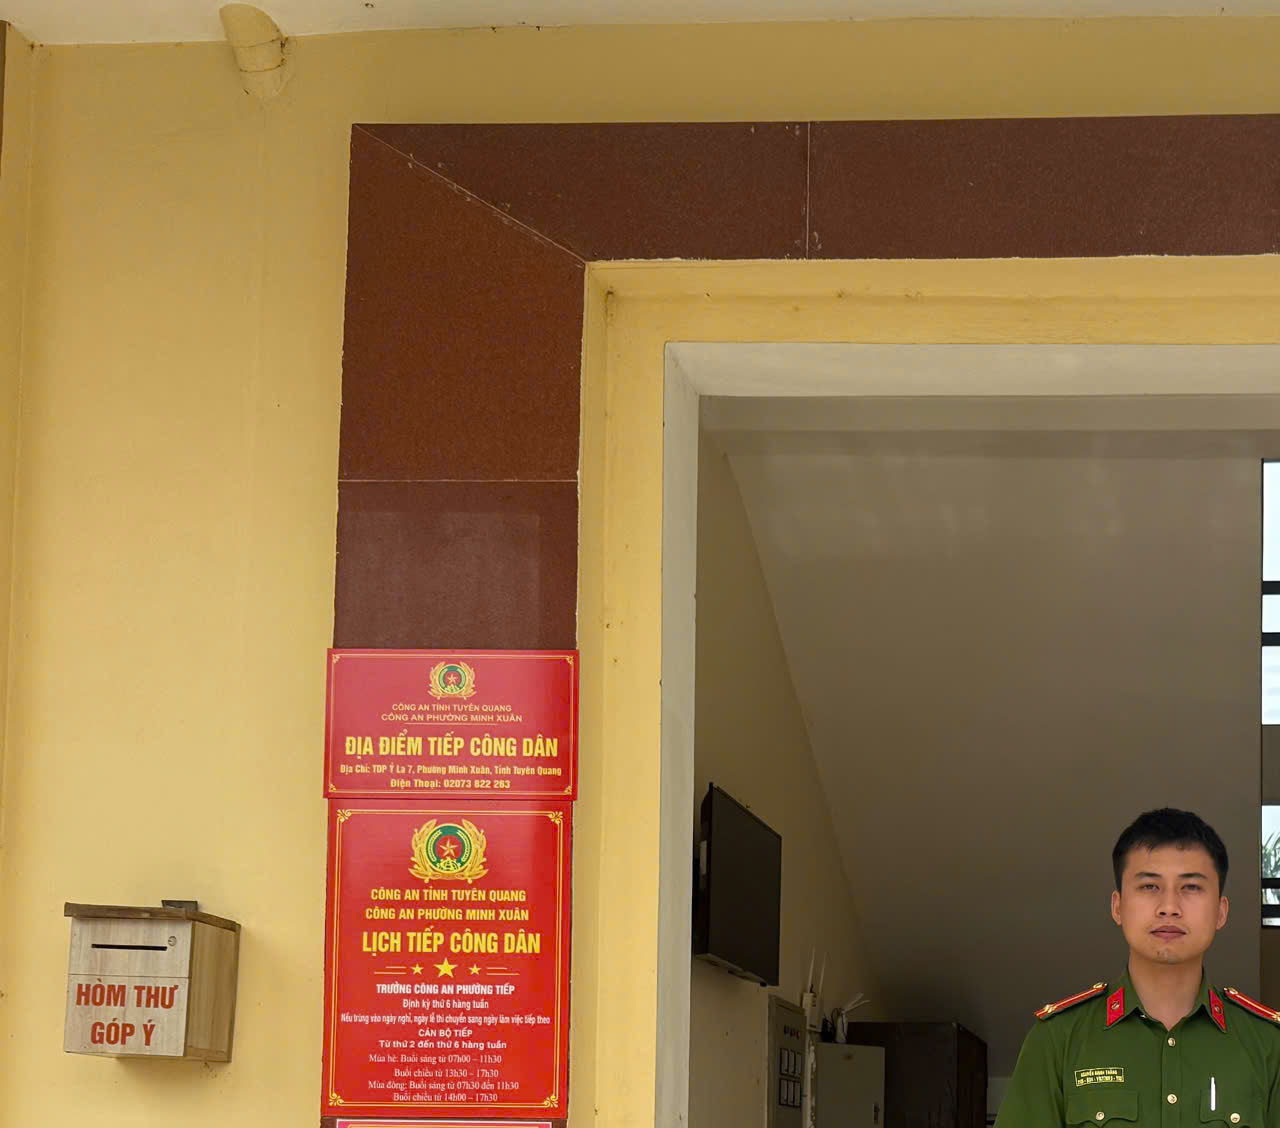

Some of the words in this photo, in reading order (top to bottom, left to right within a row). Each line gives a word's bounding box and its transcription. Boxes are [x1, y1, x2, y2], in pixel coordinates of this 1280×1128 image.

[345, 736, 374, 759] ĐỊA
[379, 729, 422, 756] ĐIỂM
[428, 731, 464, 756] TIẾP
[470, 734, 516, 757] CÔNG
[522, 734, 558, 757] DÂN
[371, 887, 401, 900] CÔNG
[404, 889, 420, 901] AN
[423, 886, 448, 901] TỈNH
[451, 888, 485, 901] TUYÊN
[490, 890, 526, 902] QUANG
[365, 907, 395, 920] CÔNG
[399, 909, 414, 920] AN
[418, 907, 463, 920] PHƯỜNG
[466, 910, 495, 920] MINH
[499, 907, 529, 921] XUÂN
[363, 932, 401, 956] LỊCH
[407, 925, 444, 953] TIẾP
[450, 929, 498, 953] CÔNG
[504, 929, 540, 953] DÂN
[76, 978, 126, 1008] HÒM
[134, 985, 179, 1009] THƯ
[376, 982, 412, 995] TRƯỞNG
[414, 982, 439, 995] CÔNG
[441, 984, 454, 995] AN
[456, 983, 492, 995] PHƯỜNG
[495, 982, 515, 995] TIẾP
[91, 1018, 135, 1045] GÓP
[142, 1019, 156, 1046] Ý
[418, 1027, 436, 1037] CÁN
[439, 1028, 452, 1038] BỘ
[453, 1027, 473, 1037] TIẾP
